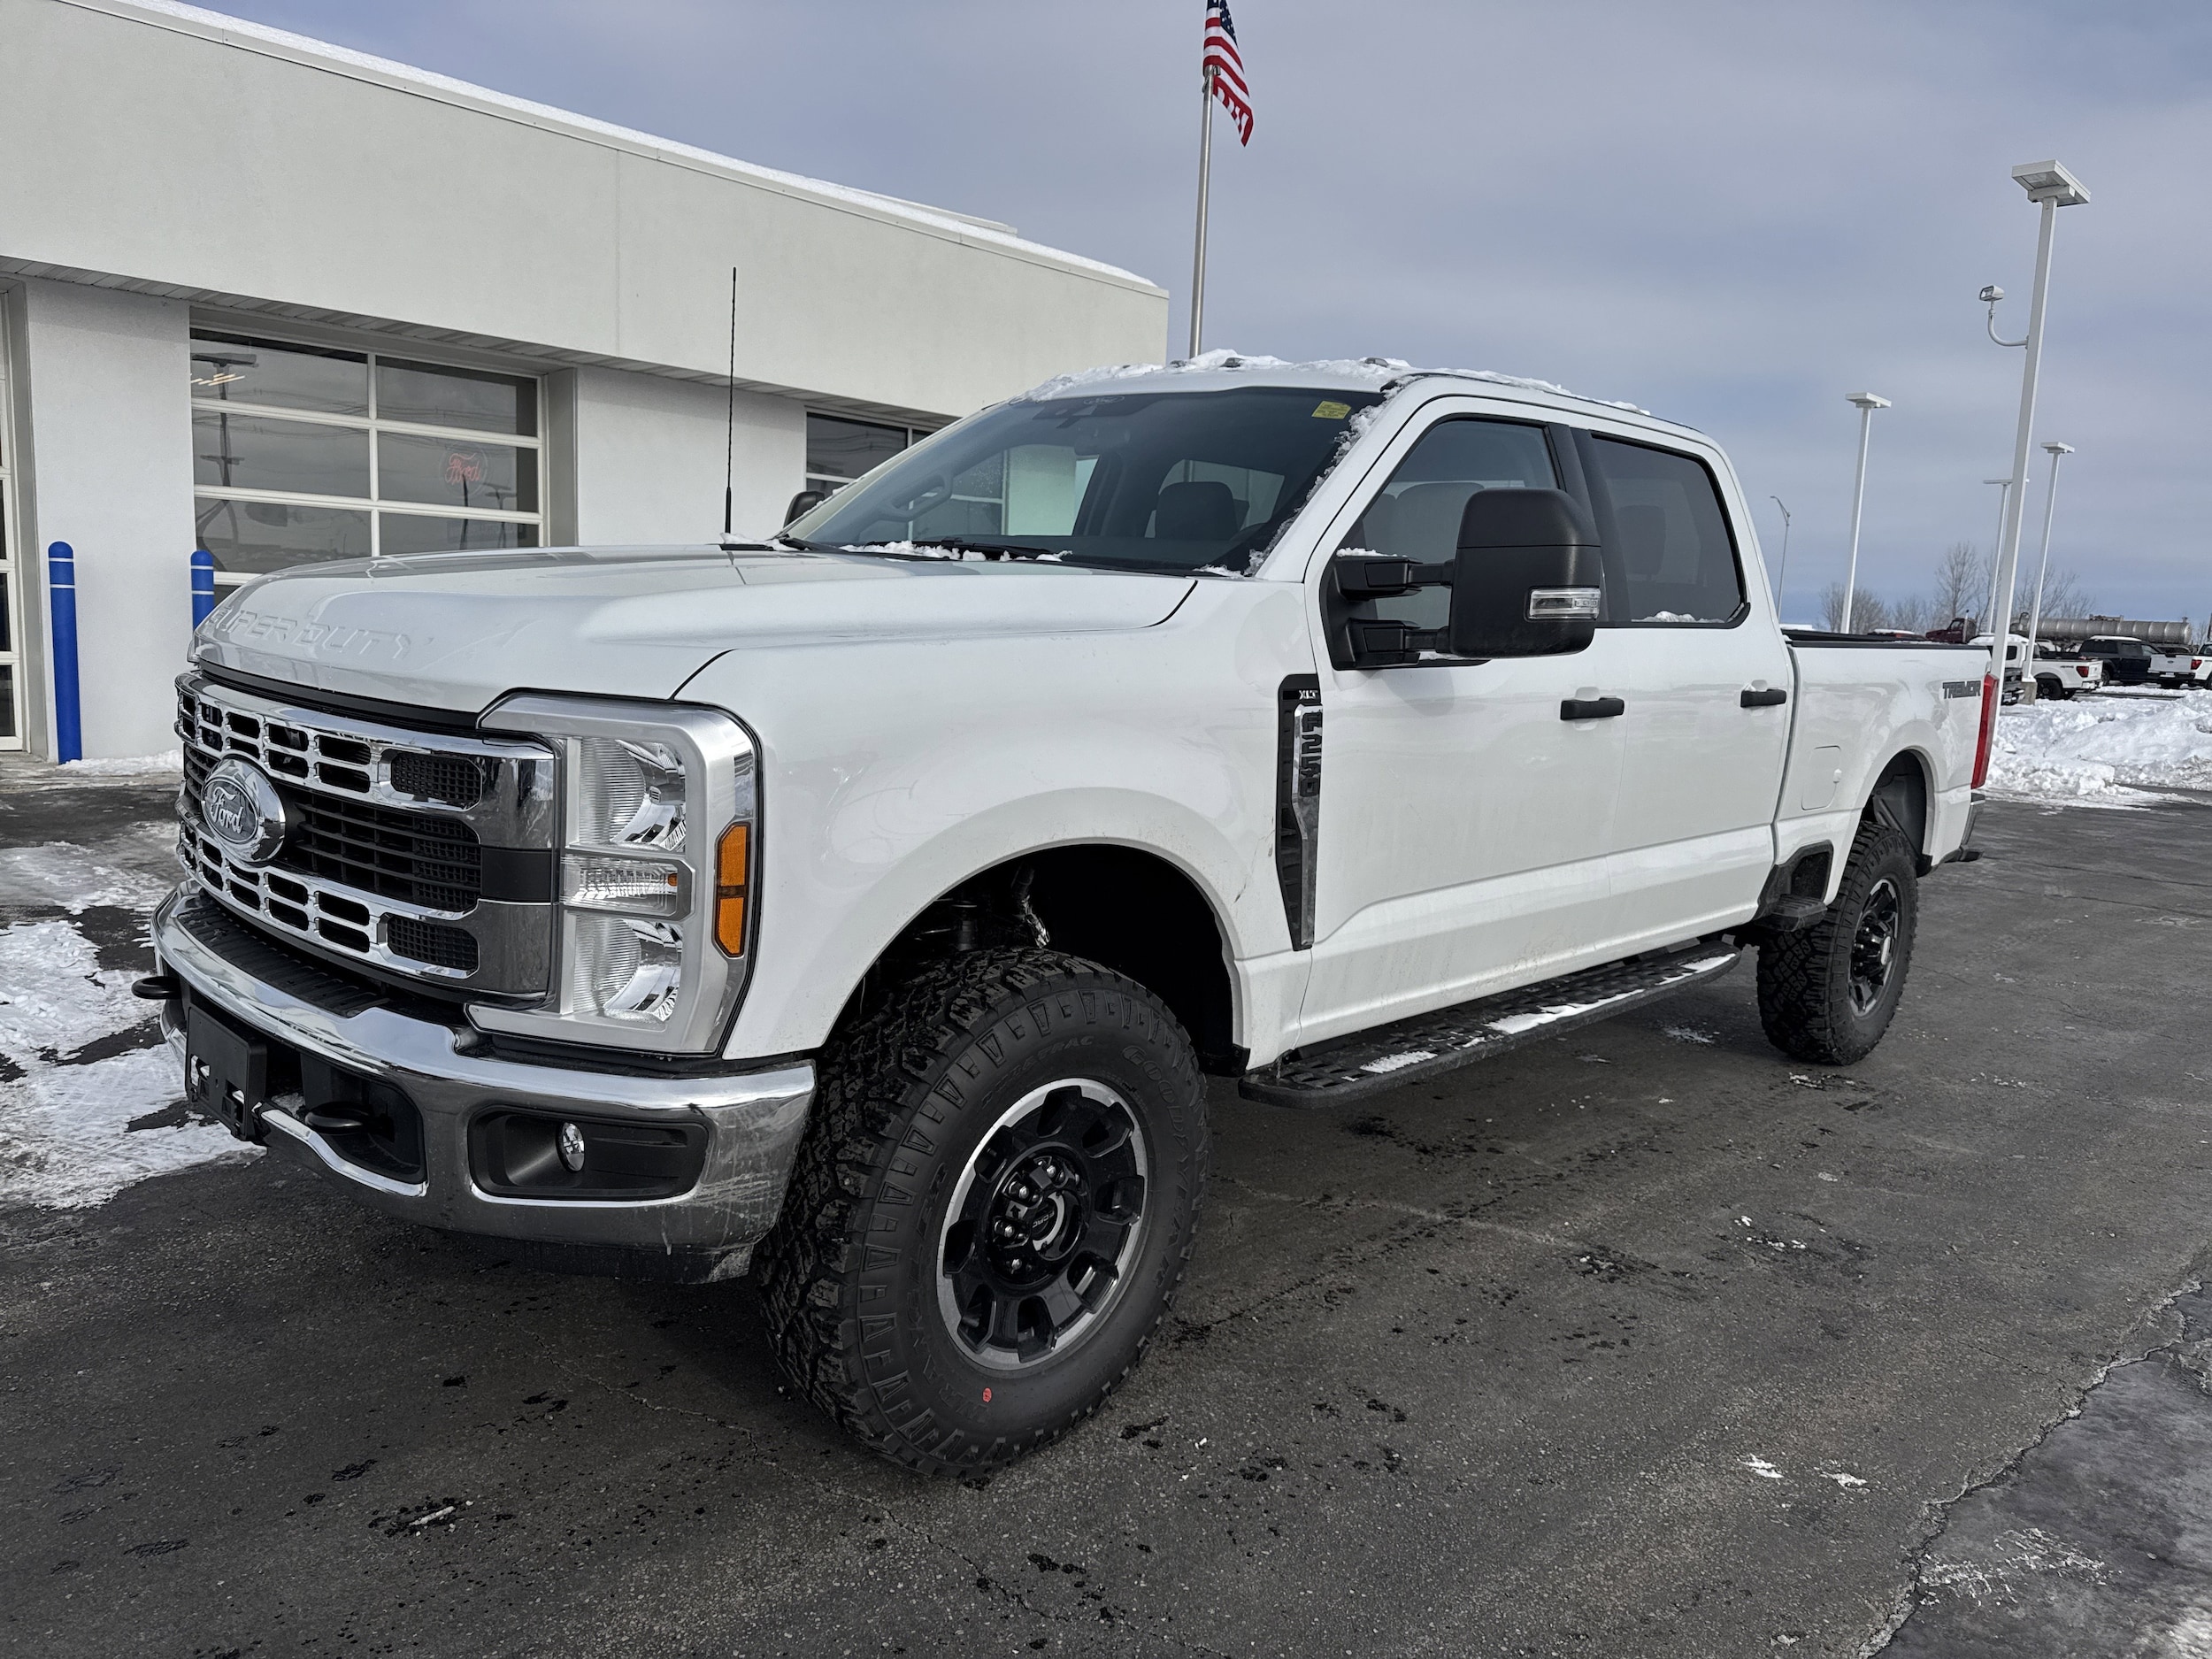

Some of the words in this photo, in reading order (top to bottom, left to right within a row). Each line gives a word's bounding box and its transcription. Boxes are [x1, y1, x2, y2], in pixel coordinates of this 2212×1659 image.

[445, 452, 481, 486] Ford
[291, 621, 411, 660] DUTY
[1298, 689, 1318, 700] XLT
[1942, 680, 1981, 699] TREMOR
[210, 786, 244, 834] Ford
[1120, 1045, 1190, 1289] GOODYEAR
